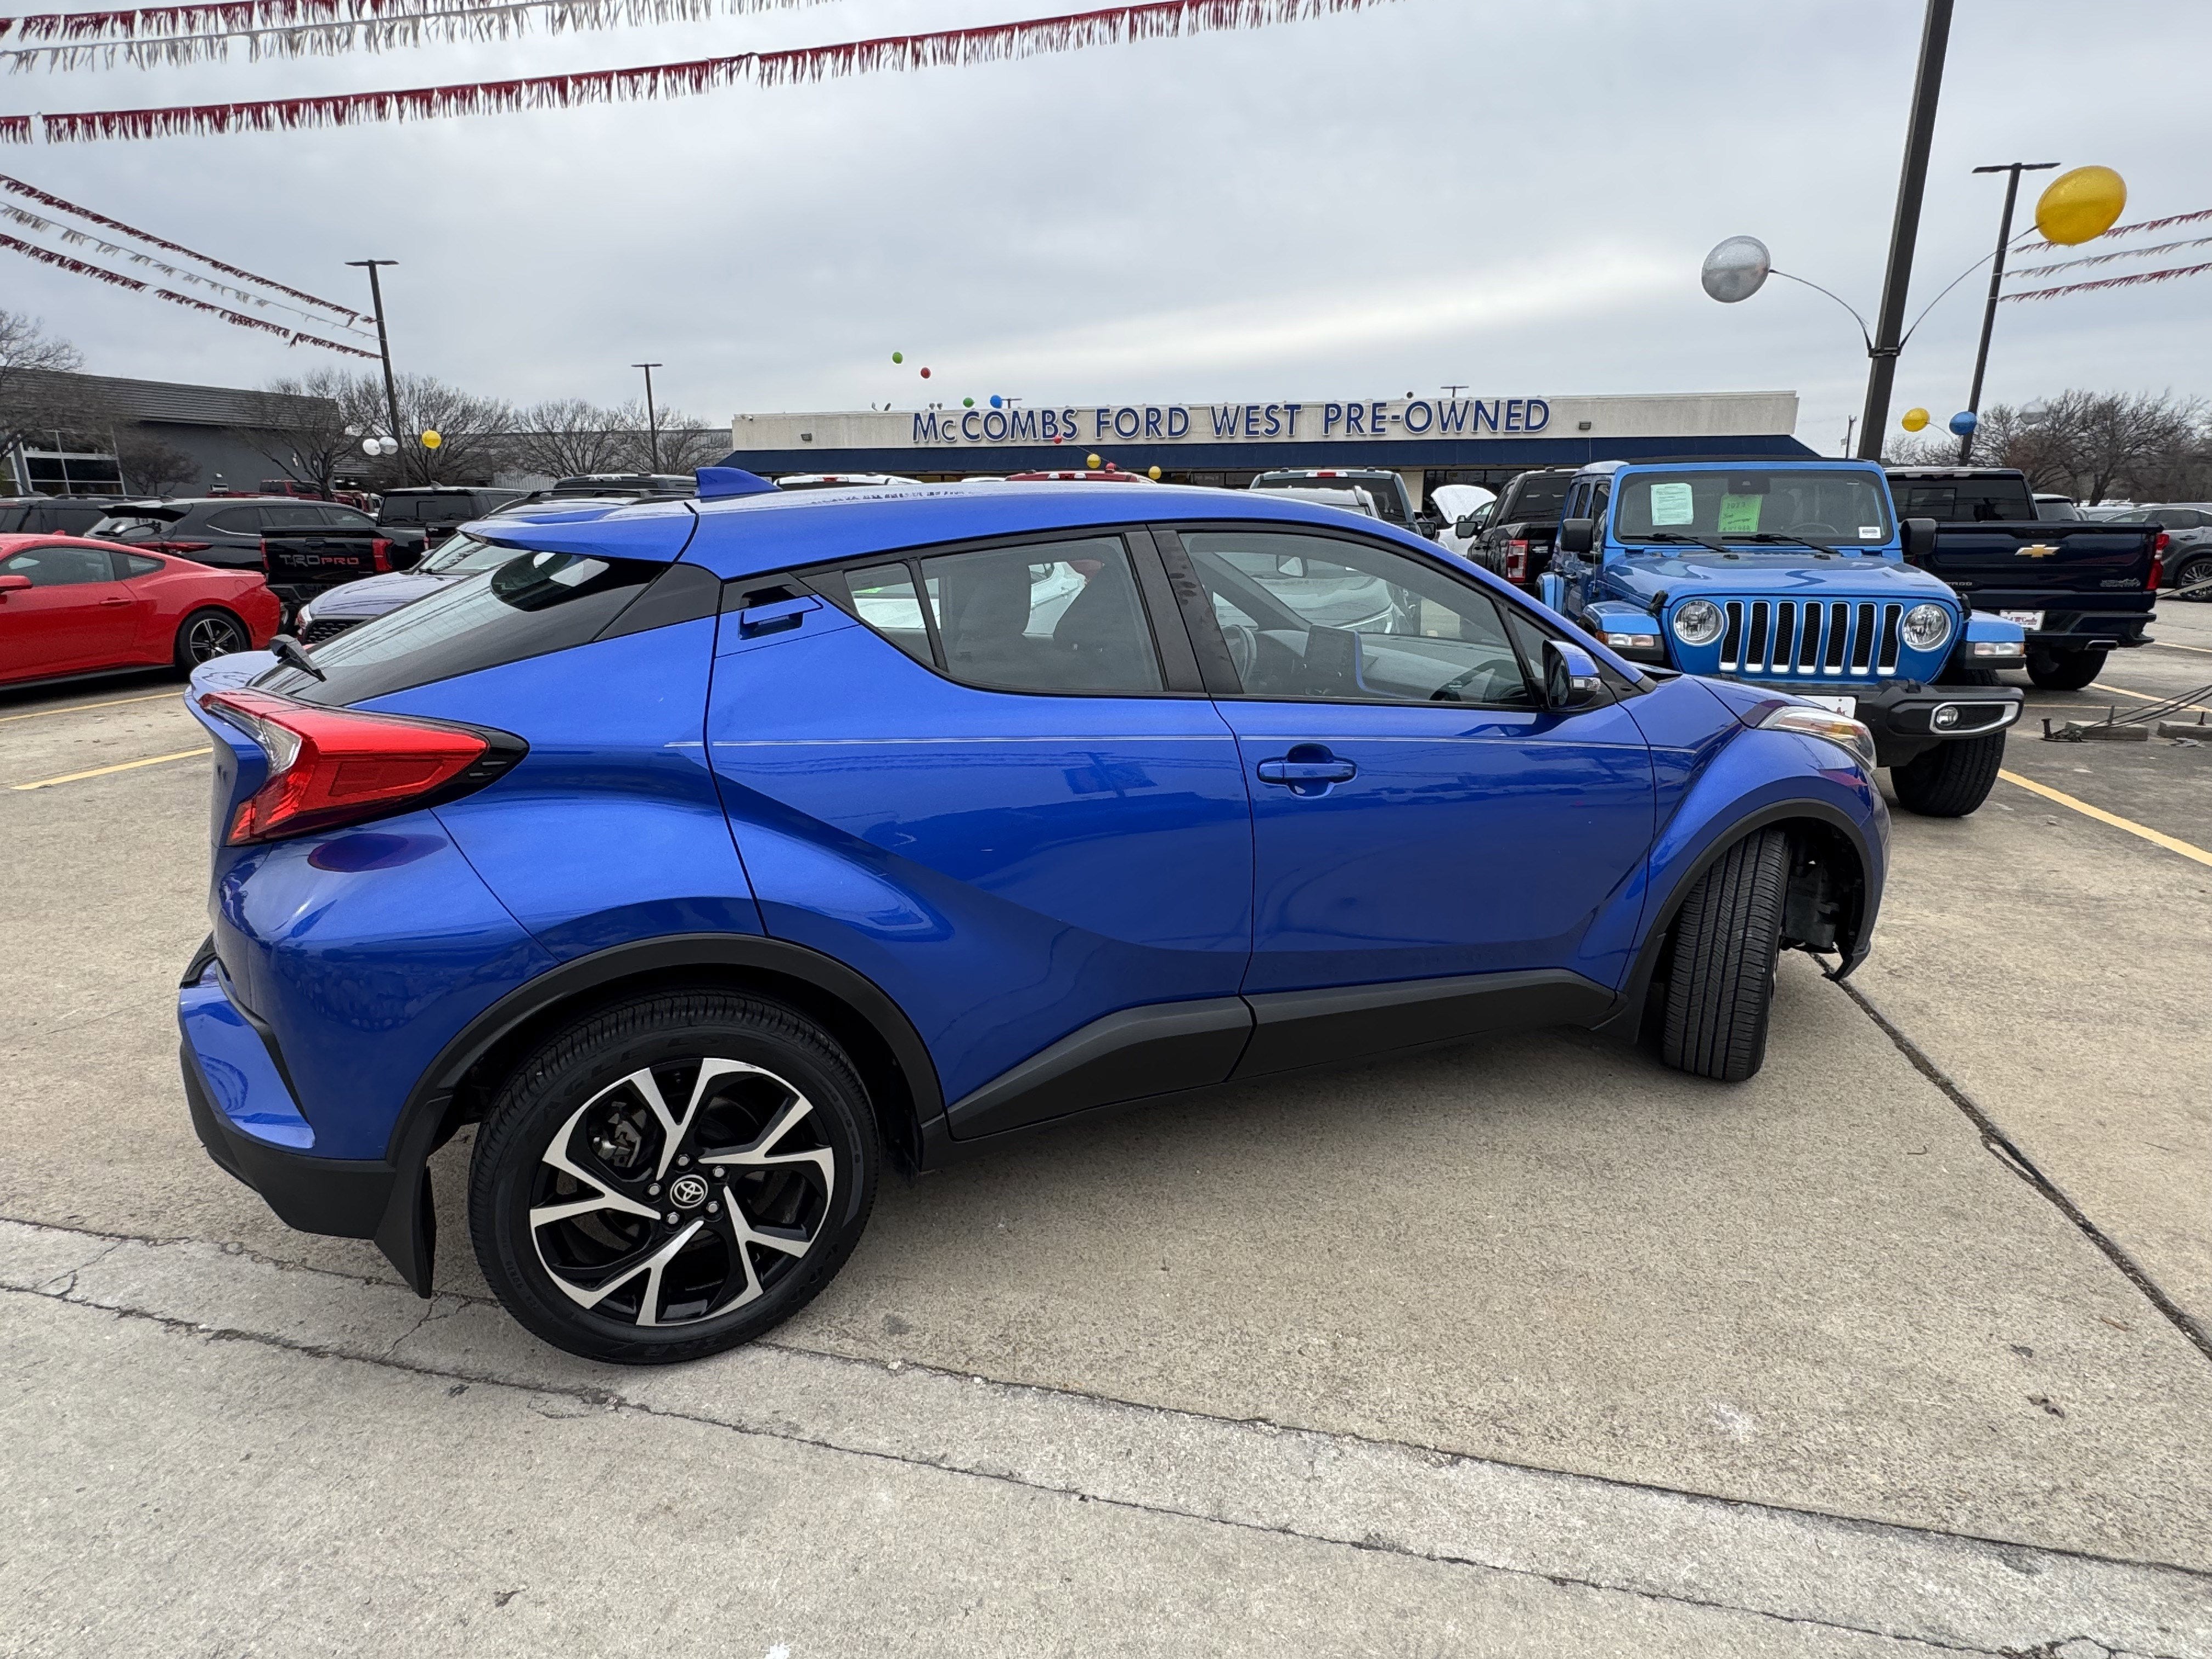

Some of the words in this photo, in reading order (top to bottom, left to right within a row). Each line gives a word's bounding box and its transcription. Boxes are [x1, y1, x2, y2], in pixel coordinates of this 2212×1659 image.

[1095, 406, 1190, 439] FORD
[1210, 403, 1302, 437] WEST
[1323, 398, 1550, 436] PRE-OWNED
